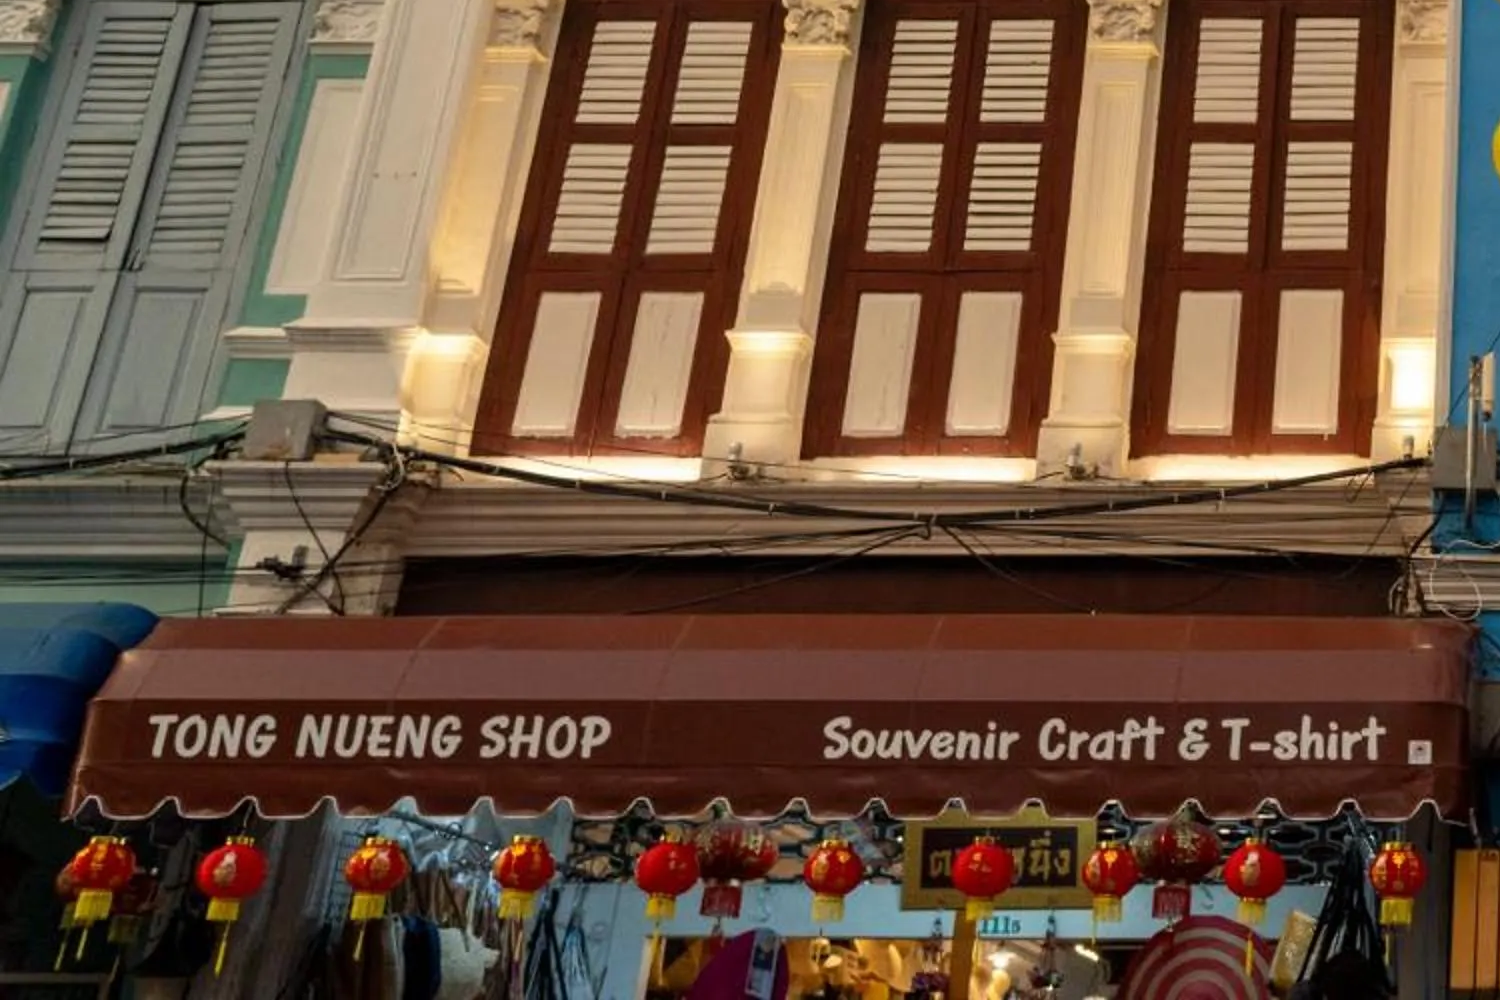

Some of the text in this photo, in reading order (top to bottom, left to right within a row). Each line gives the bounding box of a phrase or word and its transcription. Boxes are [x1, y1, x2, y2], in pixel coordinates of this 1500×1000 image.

[150, 714, 612, 759] TONG NUENG SHOP
[823, 716, 1020, 761] Souvenir
[1039, 716, 1165, 761] Craft
[1178, 718, 1210, 761] &
[1221, 714, 1387, 761] T-shirt
